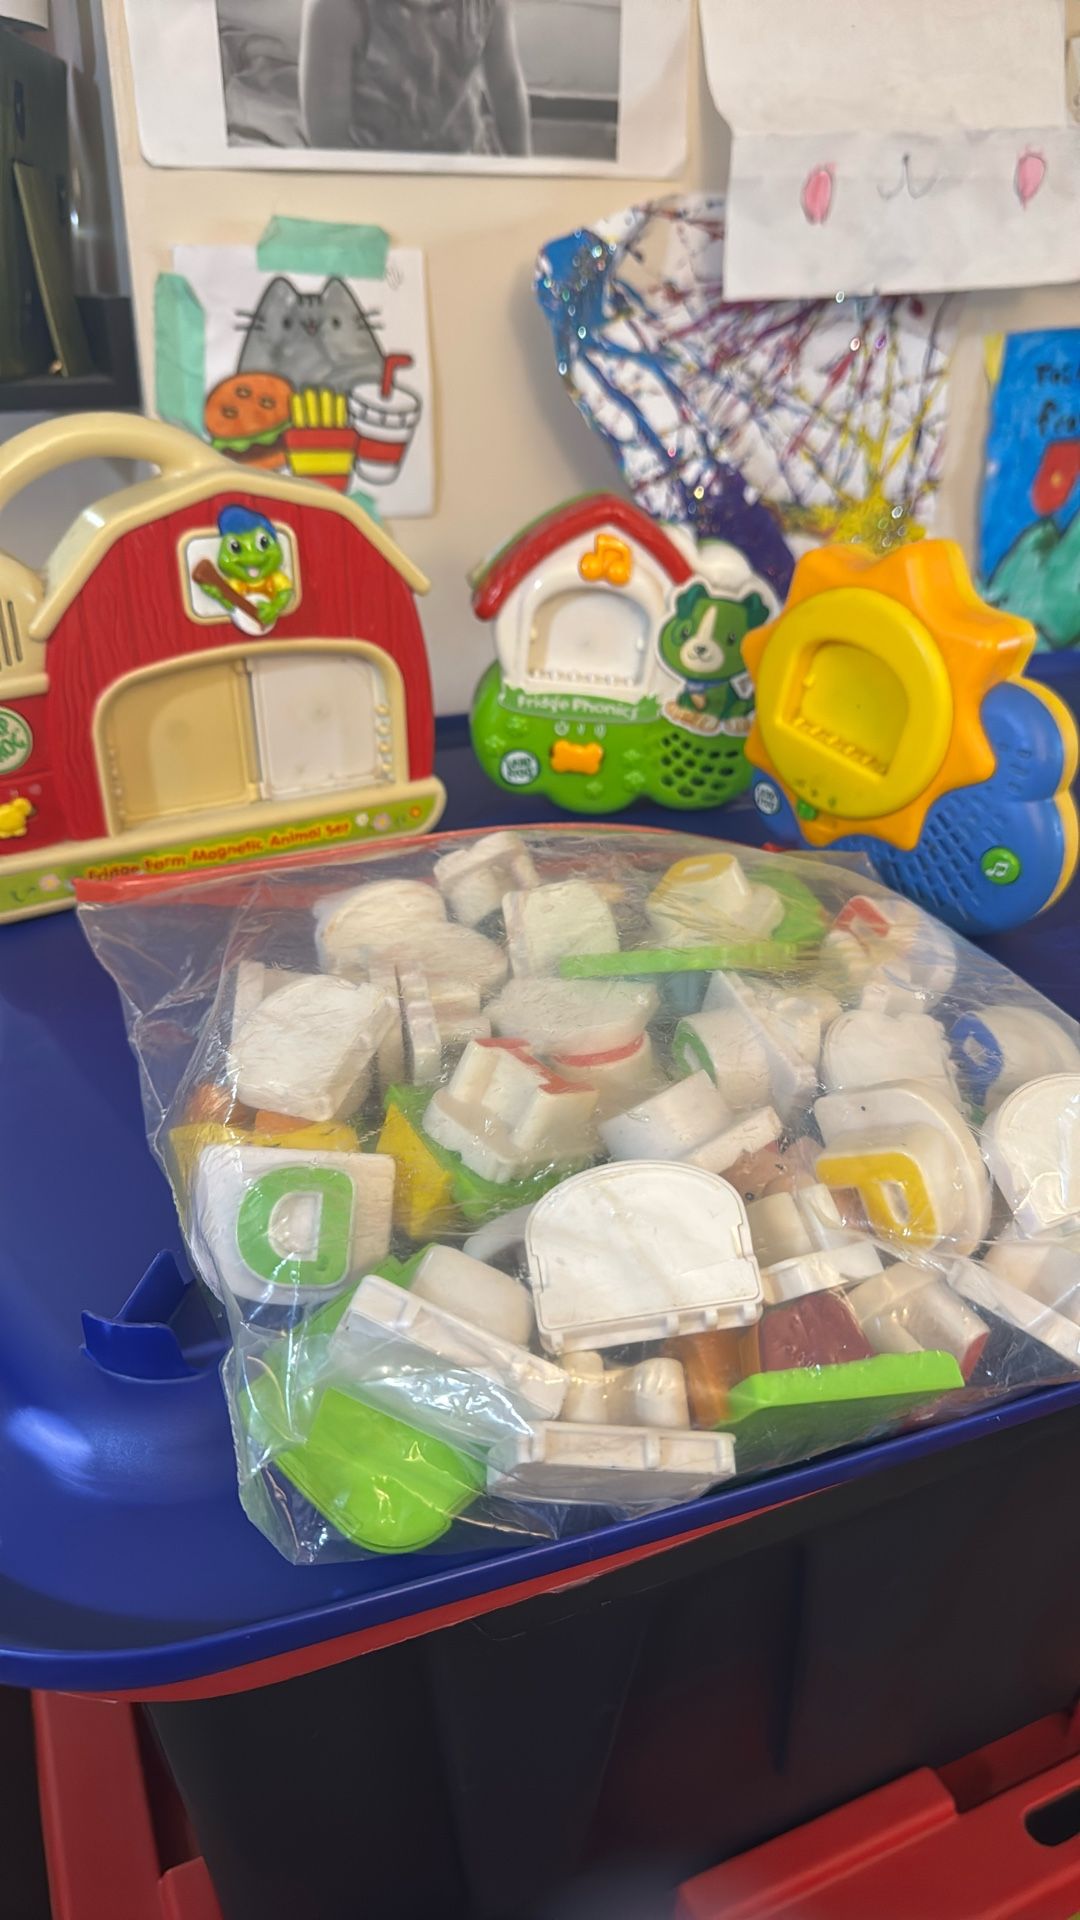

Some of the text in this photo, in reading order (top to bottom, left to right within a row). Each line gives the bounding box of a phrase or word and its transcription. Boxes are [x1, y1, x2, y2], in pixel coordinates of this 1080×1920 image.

[517, 694, 639, 721] Fridge Phonics
[143, 855, 186, 872] Farm
[192, 838, 263, 861] Magnetic
[270, 827, 321, 847] Animal
